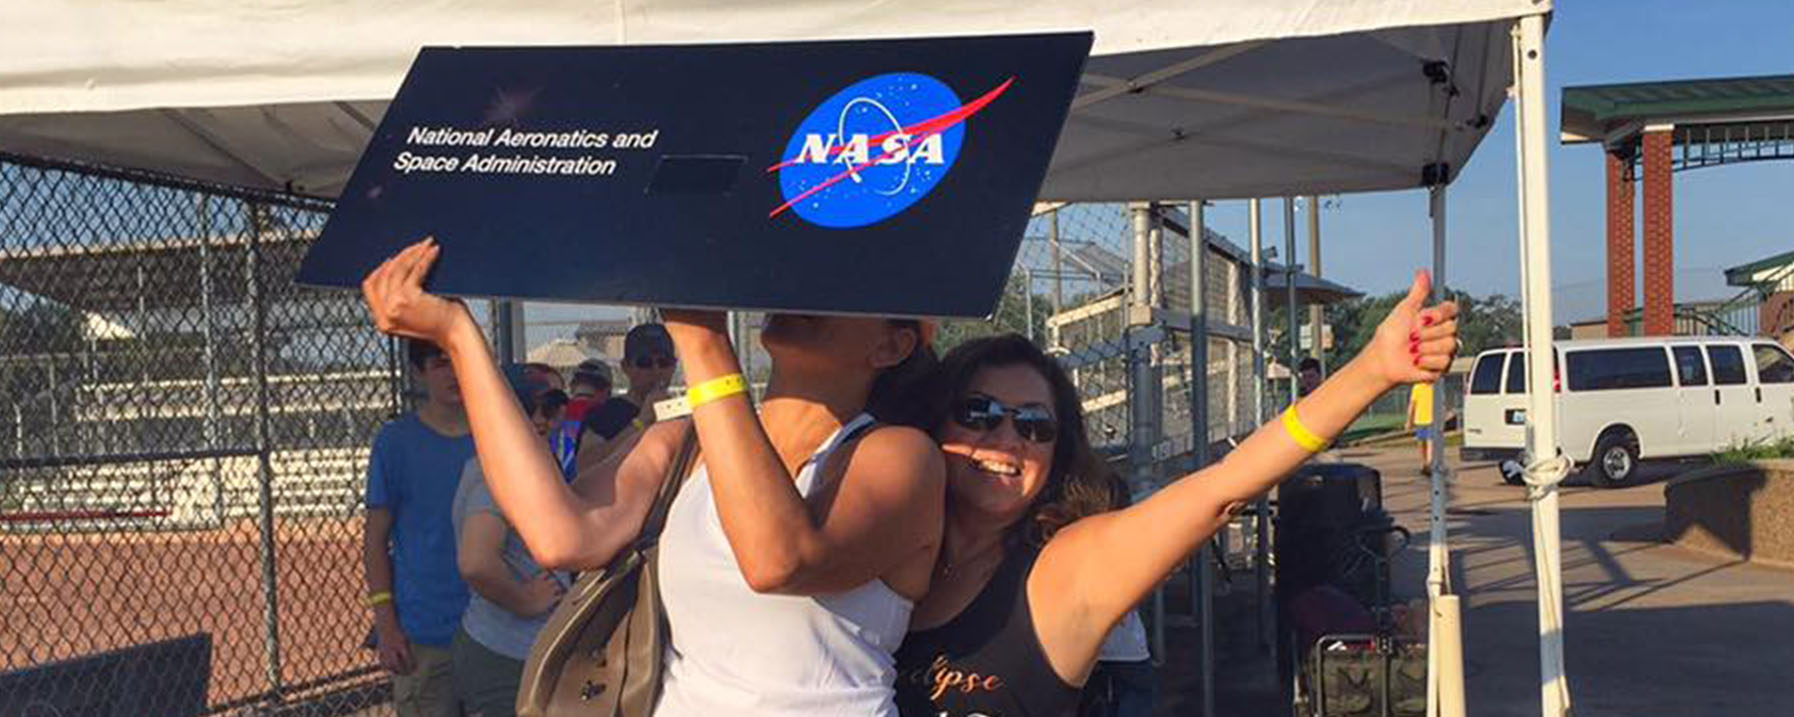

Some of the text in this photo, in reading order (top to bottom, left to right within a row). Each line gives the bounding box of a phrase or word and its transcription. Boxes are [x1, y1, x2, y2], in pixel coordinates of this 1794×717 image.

[406, 126, 659, 149] National Aeronatics and
[794, 133, 945, 165] NASA
[393, 152, 617, 175] Space Administration
